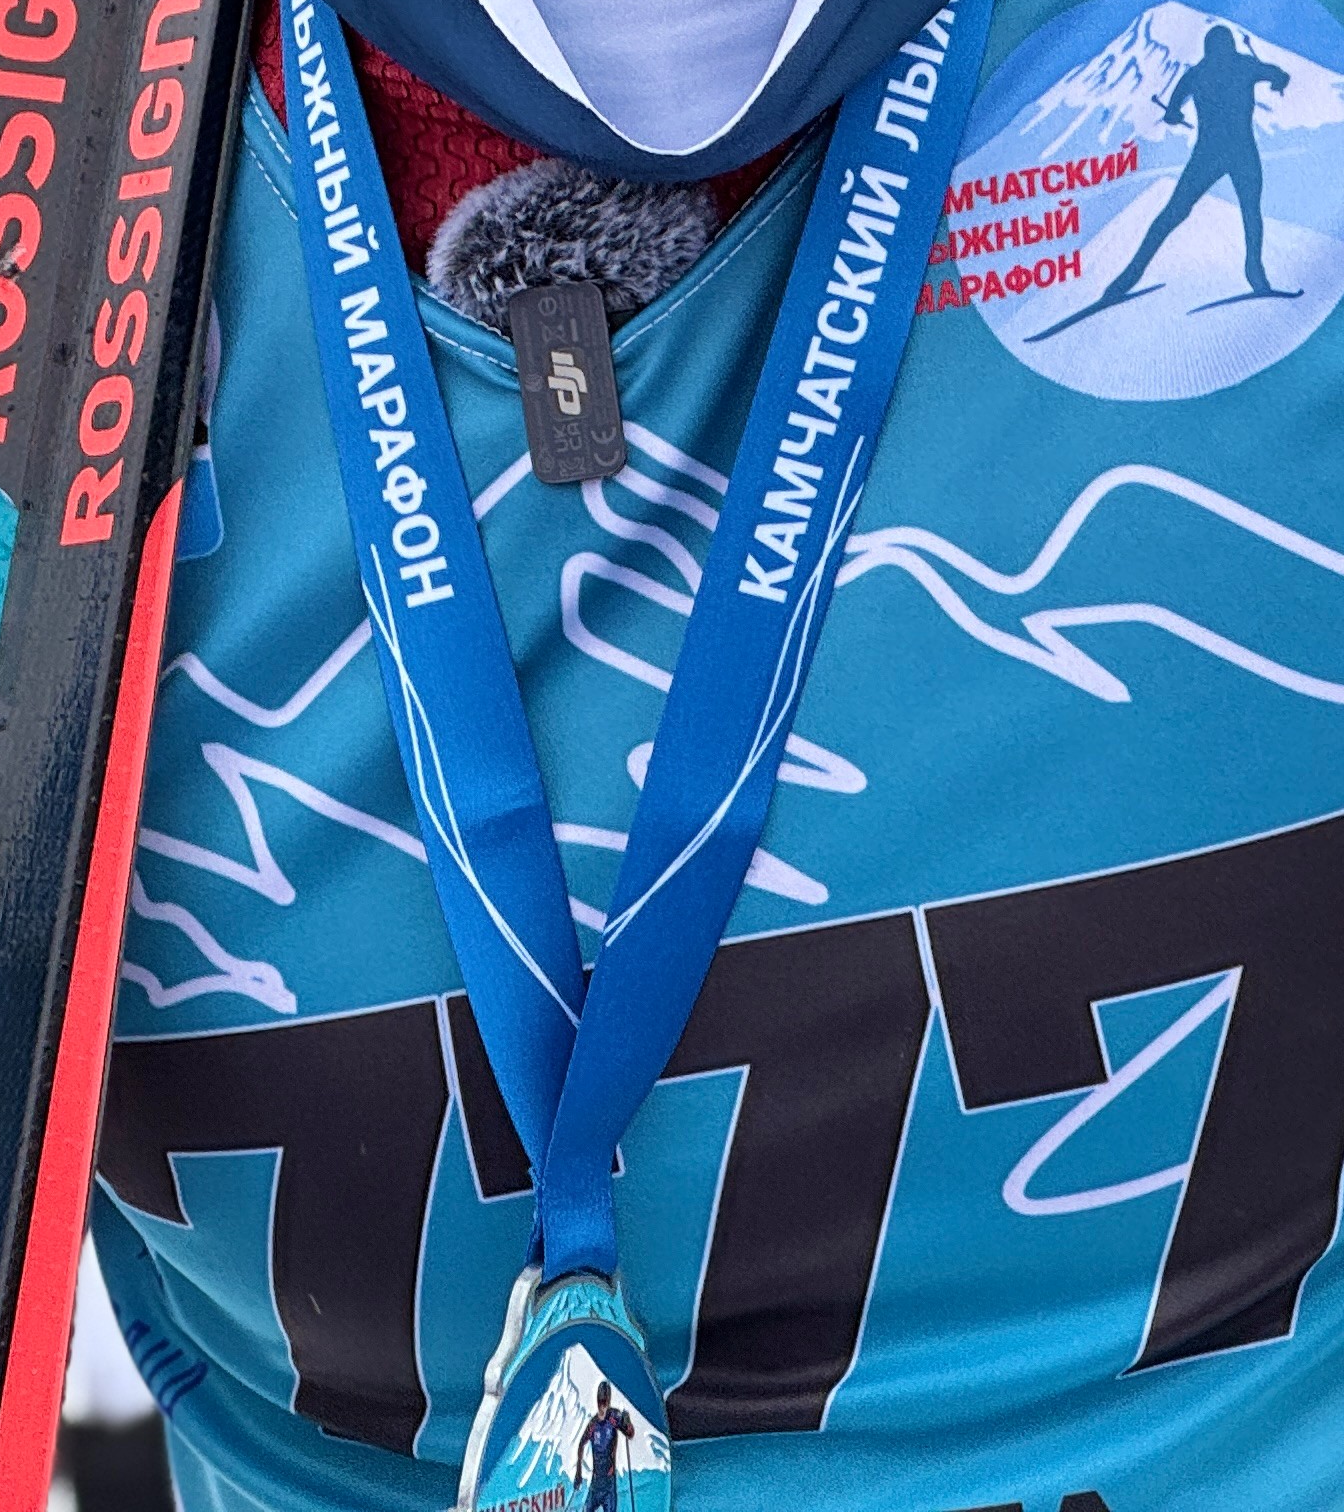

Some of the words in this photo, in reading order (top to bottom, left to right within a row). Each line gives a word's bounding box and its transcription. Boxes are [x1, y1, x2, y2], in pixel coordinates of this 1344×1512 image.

[928, 199, 1081, 266] ЫЖНЫЙ
[943, 140, 1140, 215] МЧАТСКИЙ
[341, 287, 454, 607] МАРАФОН
[739, 162, 908, 603] КАМЧАТСКИЙ
